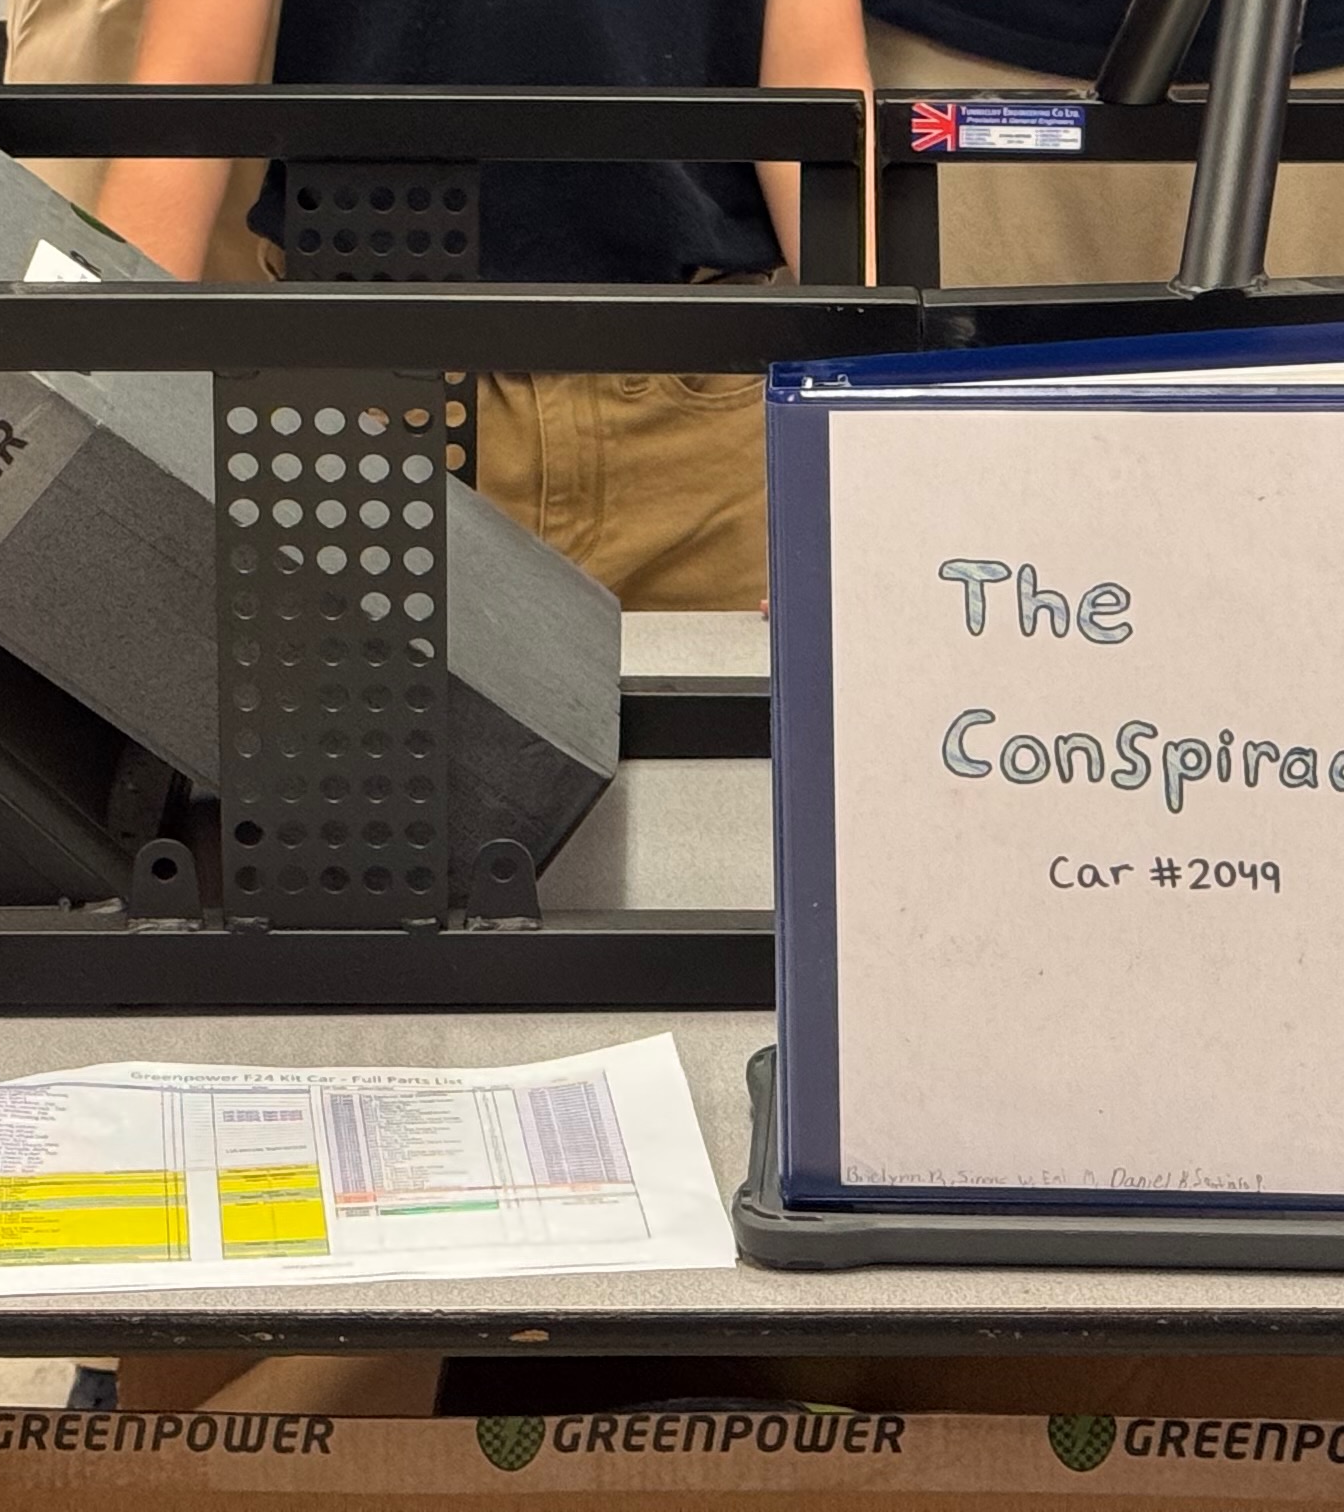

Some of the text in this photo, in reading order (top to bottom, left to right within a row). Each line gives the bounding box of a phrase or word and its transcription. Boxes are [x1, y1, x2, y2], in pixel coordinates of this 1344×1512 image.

[938, 558, 1134, 645] The
[1049, 855, 1281, 894] Car #2049
[130, 1071, 239, 1083] Greenpower
[280, 1074, 302, 1083] Kit
[307, 1074, 336, 1083] Car
[352, 1075, 382, 1084] Full
[387, 1075, 430, 1085] Parts
[435, 1076, 463, 1086] List
[1109, 1166, 1172, 1188] Daniel
[552, 1414, 906, 1454] GREENPOWER
